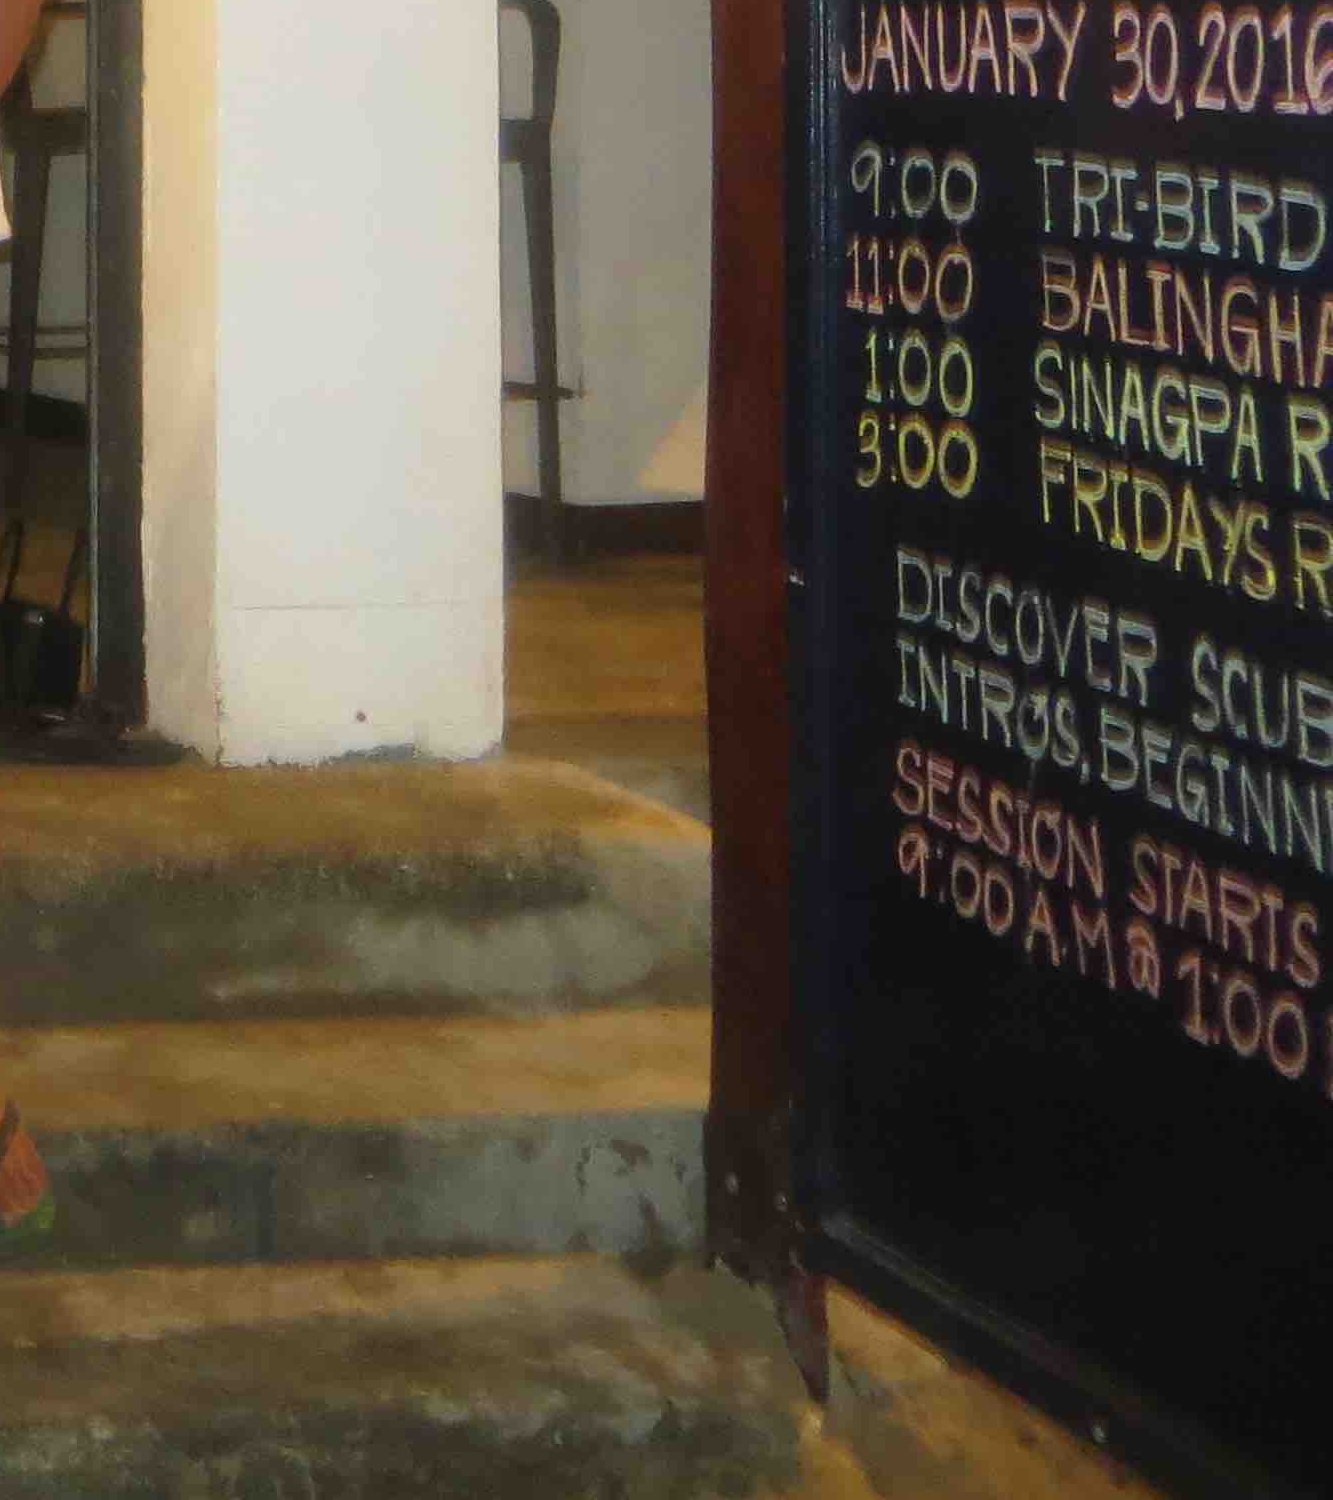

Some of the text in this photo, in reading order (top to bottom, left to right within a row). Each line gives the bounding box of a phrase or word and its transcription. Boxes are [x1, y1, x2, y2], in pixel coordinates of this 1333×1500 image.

[840, 0, 1086, 102] JANUARY
[851, 143, 978, 224] 9:00
[846, 238, 973, 322] 11:00
[866, 331, 975, 418] 1:00
[1035, 342, 1264, 482] SINAGPA
[856, 413, 978, 498] 3:00
[1040, 438, 1277, 598] FRIDAYS
[896, 546, 1158, 707] DISCOVER
[893, 740, 1320, 988] SESSION STARTS
